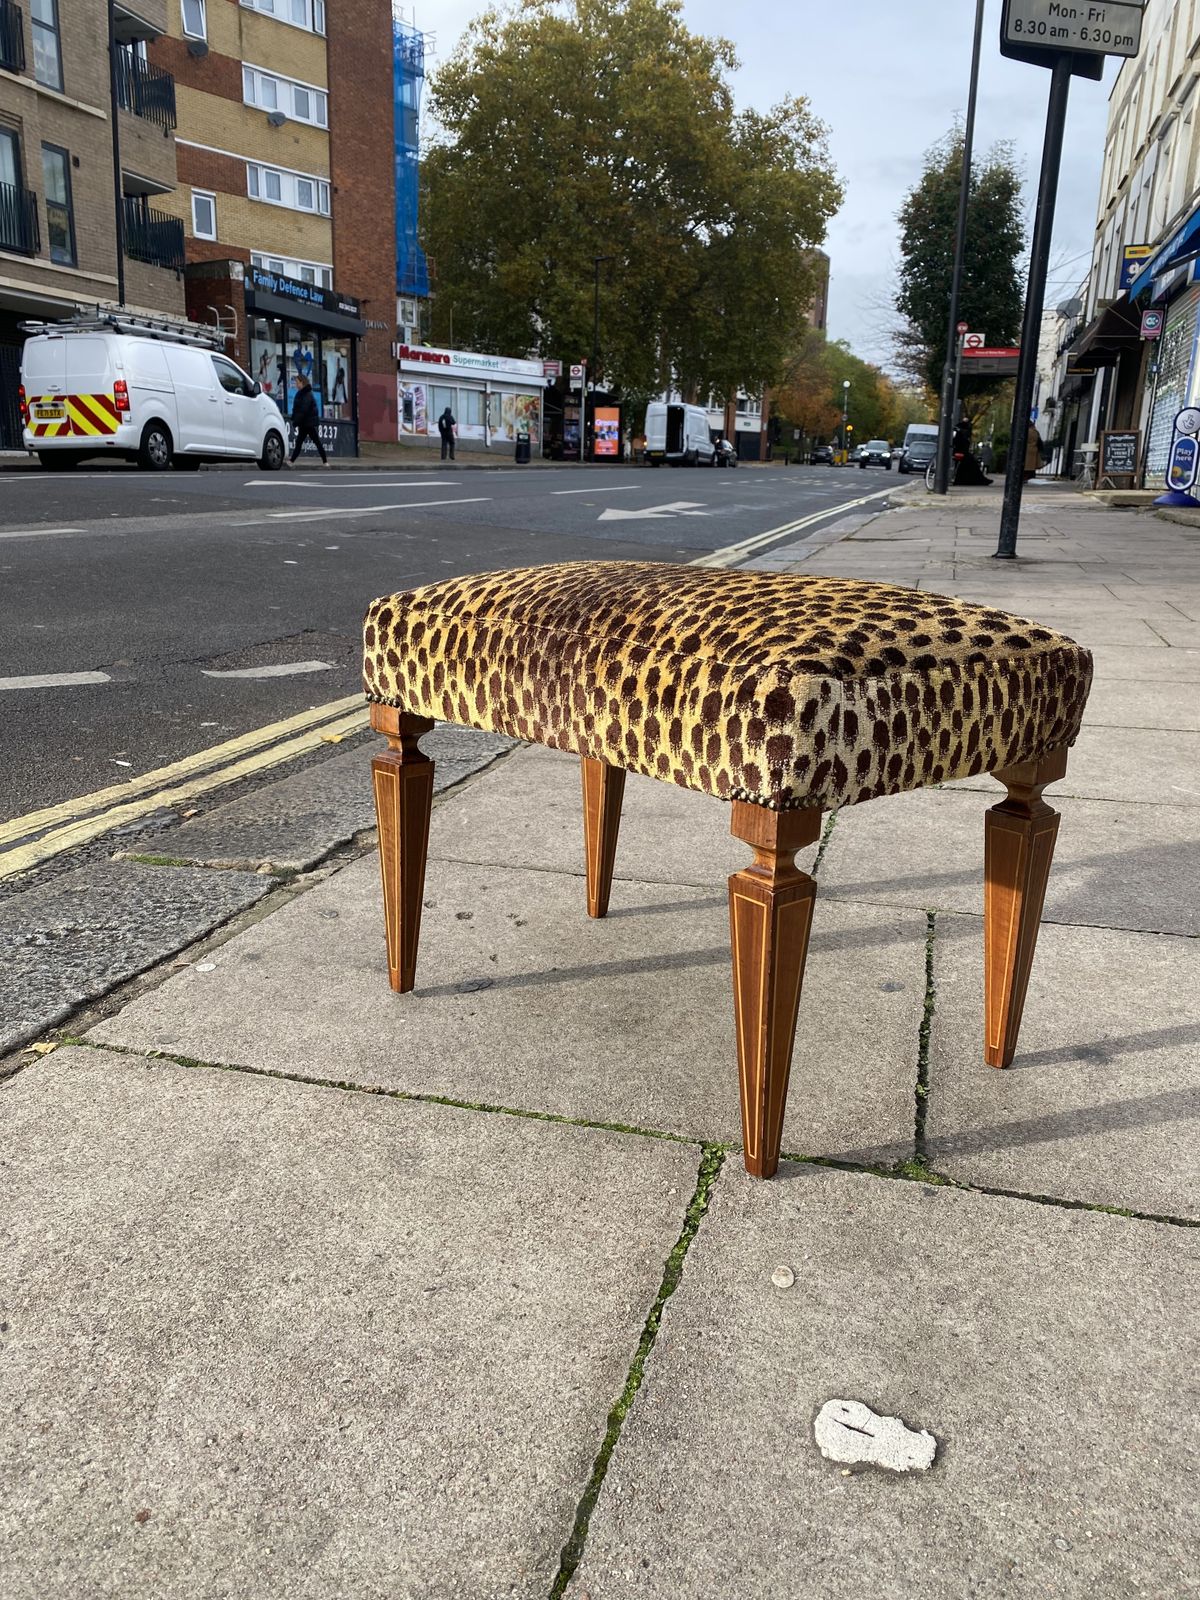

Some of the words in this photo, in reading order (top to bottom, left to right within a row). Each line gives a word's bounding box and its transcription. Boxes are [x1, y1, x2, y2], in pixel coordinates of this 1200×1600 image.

[1048, 2, 1077, 19] Mon
[1088, 8, 1106, 23] Fri
[1014, 19, 1047, 36] 8.30
[1049, 26, 1069, 38] am
[1080, 27, 1112, 43] 6.30
[1114, 34, 1134, 47] pm
[253, 270, 278, 293] Family
[279, 277, 308, 299] Defence
[309, 287, 324, 303] Law
[398, 345, 451, 365] Marmara
[452, 354, 499, 369] Supermarket
[318, 424, 338, 439] 8237
[1176, 447, 1193, 456] Play
